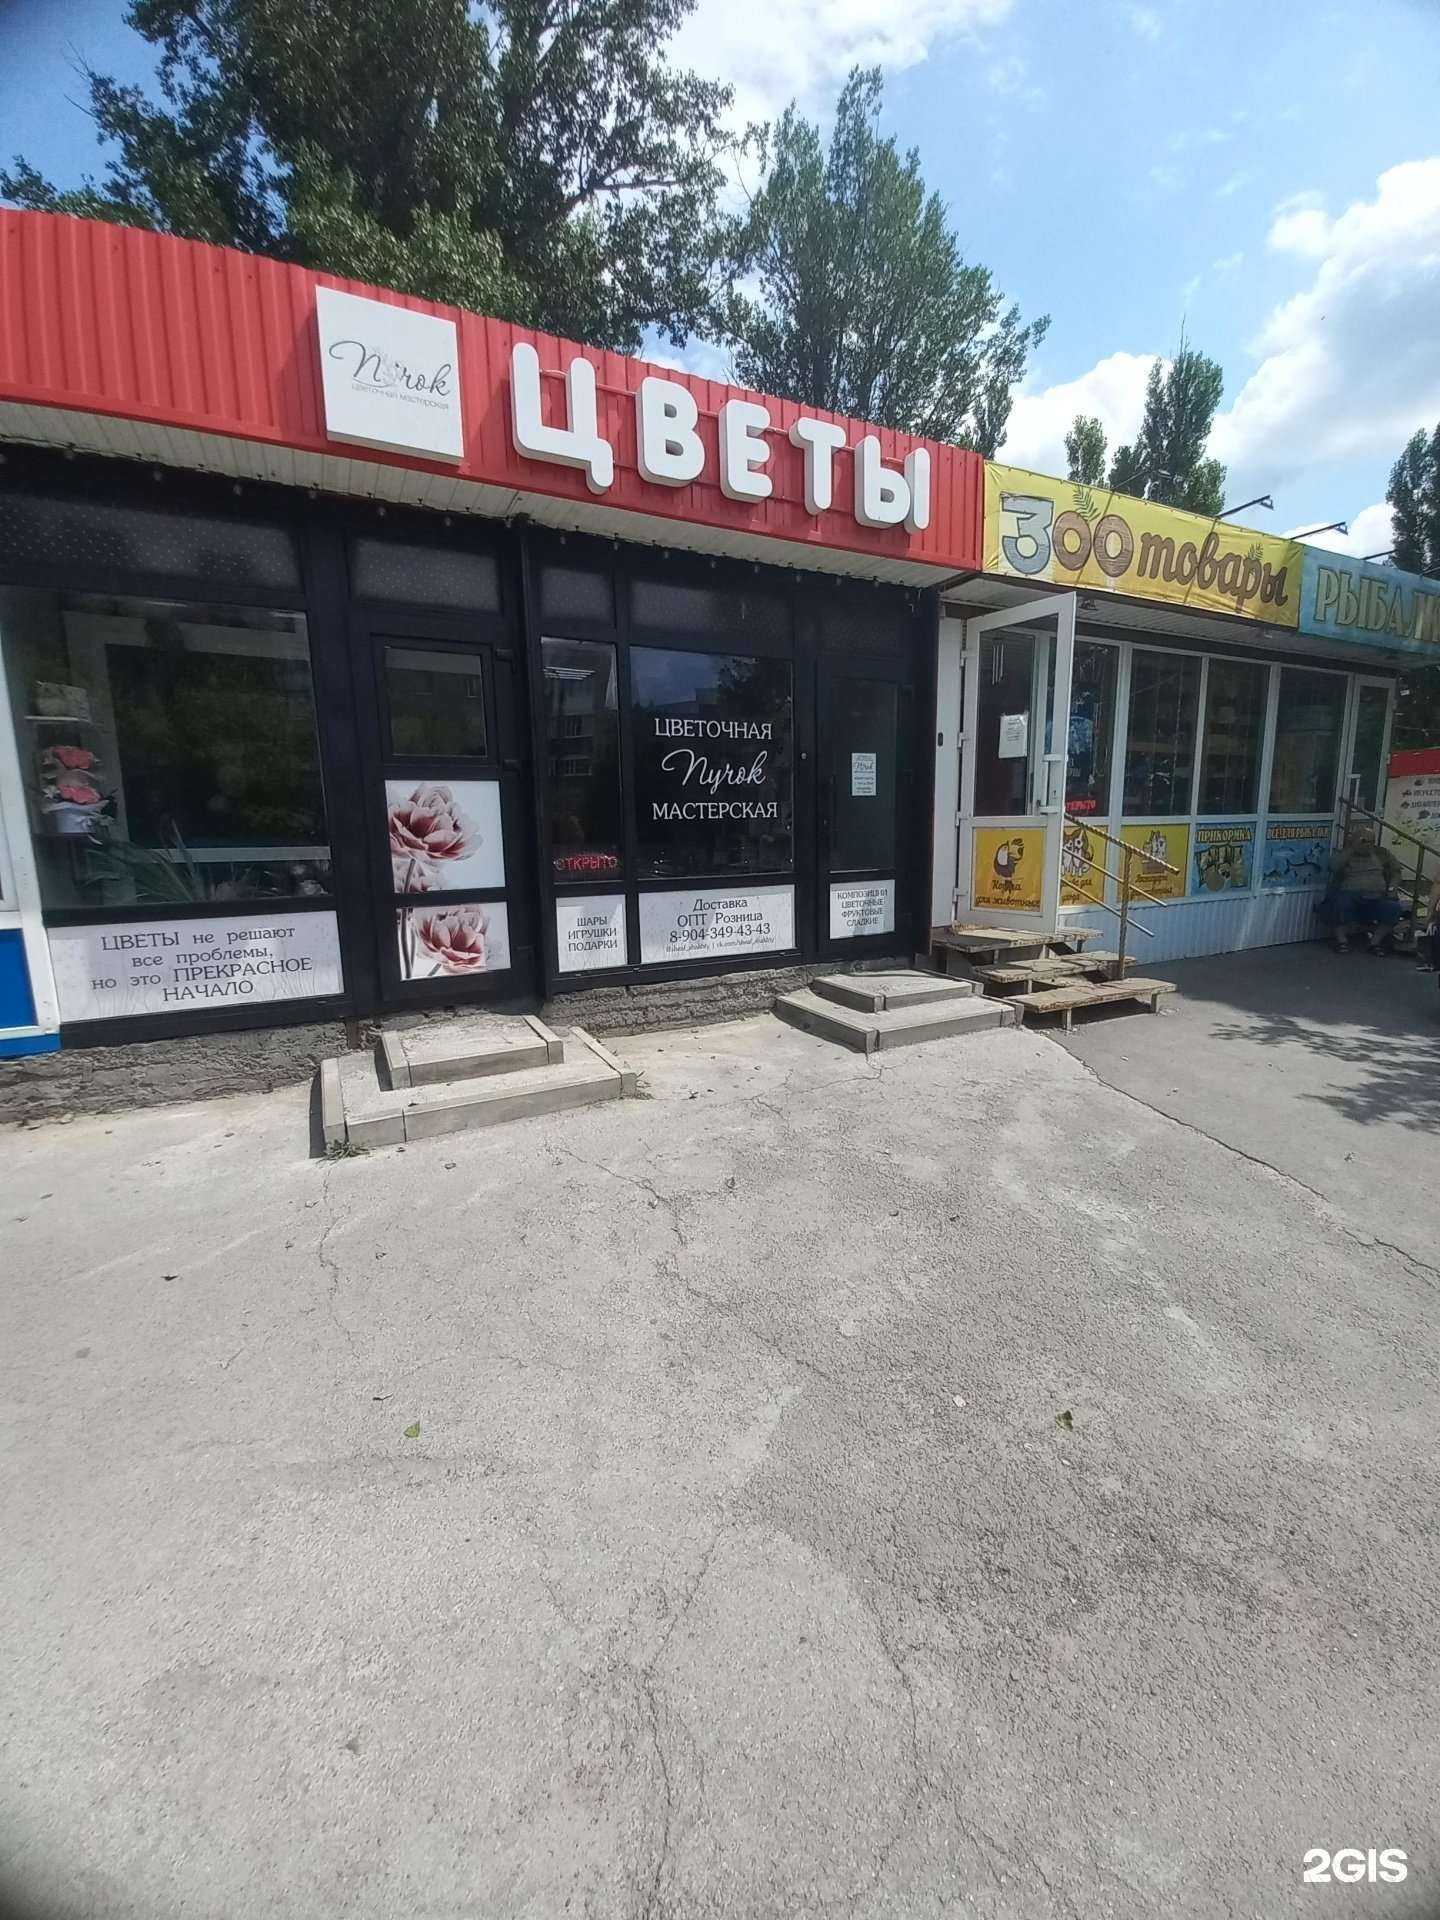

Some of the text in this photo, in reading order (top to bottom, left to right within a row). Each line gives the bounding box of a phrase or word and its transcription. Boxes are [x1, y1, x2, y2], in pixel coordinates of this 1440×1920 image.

[511, 342, 930, 532] ЦВЕТЫ
[655, 718, 772, 740] ЦВЕТОЧНАЯ
[653, 802, 778, 820] МАСТЕРСКАЯ
[553, 855, 618, 871] ОТКРЫТО
[693, 898, 748, 912] Доставка
[577, 916, 608, 927] ШАРЫ
[677, 911, 763, 928] ОПТ Розница
[847, 917, 879, 927] СЛАДКИЕ
[102, 927, 296, 951] ЦВЕТЫ не решают
[568, 928, 617, 940] ИГРУШКИ
[670, 922, 771, 943] 8-904-349-43-43
[568, 939, 618, 952] ПОДАРКИ
[132, 946, 273, 967] все проблемы,
[92, 958, 313, 990] но это ПРЕКРАСНОЕ
[163, 980, 254, 1002] НАЧАЛО
